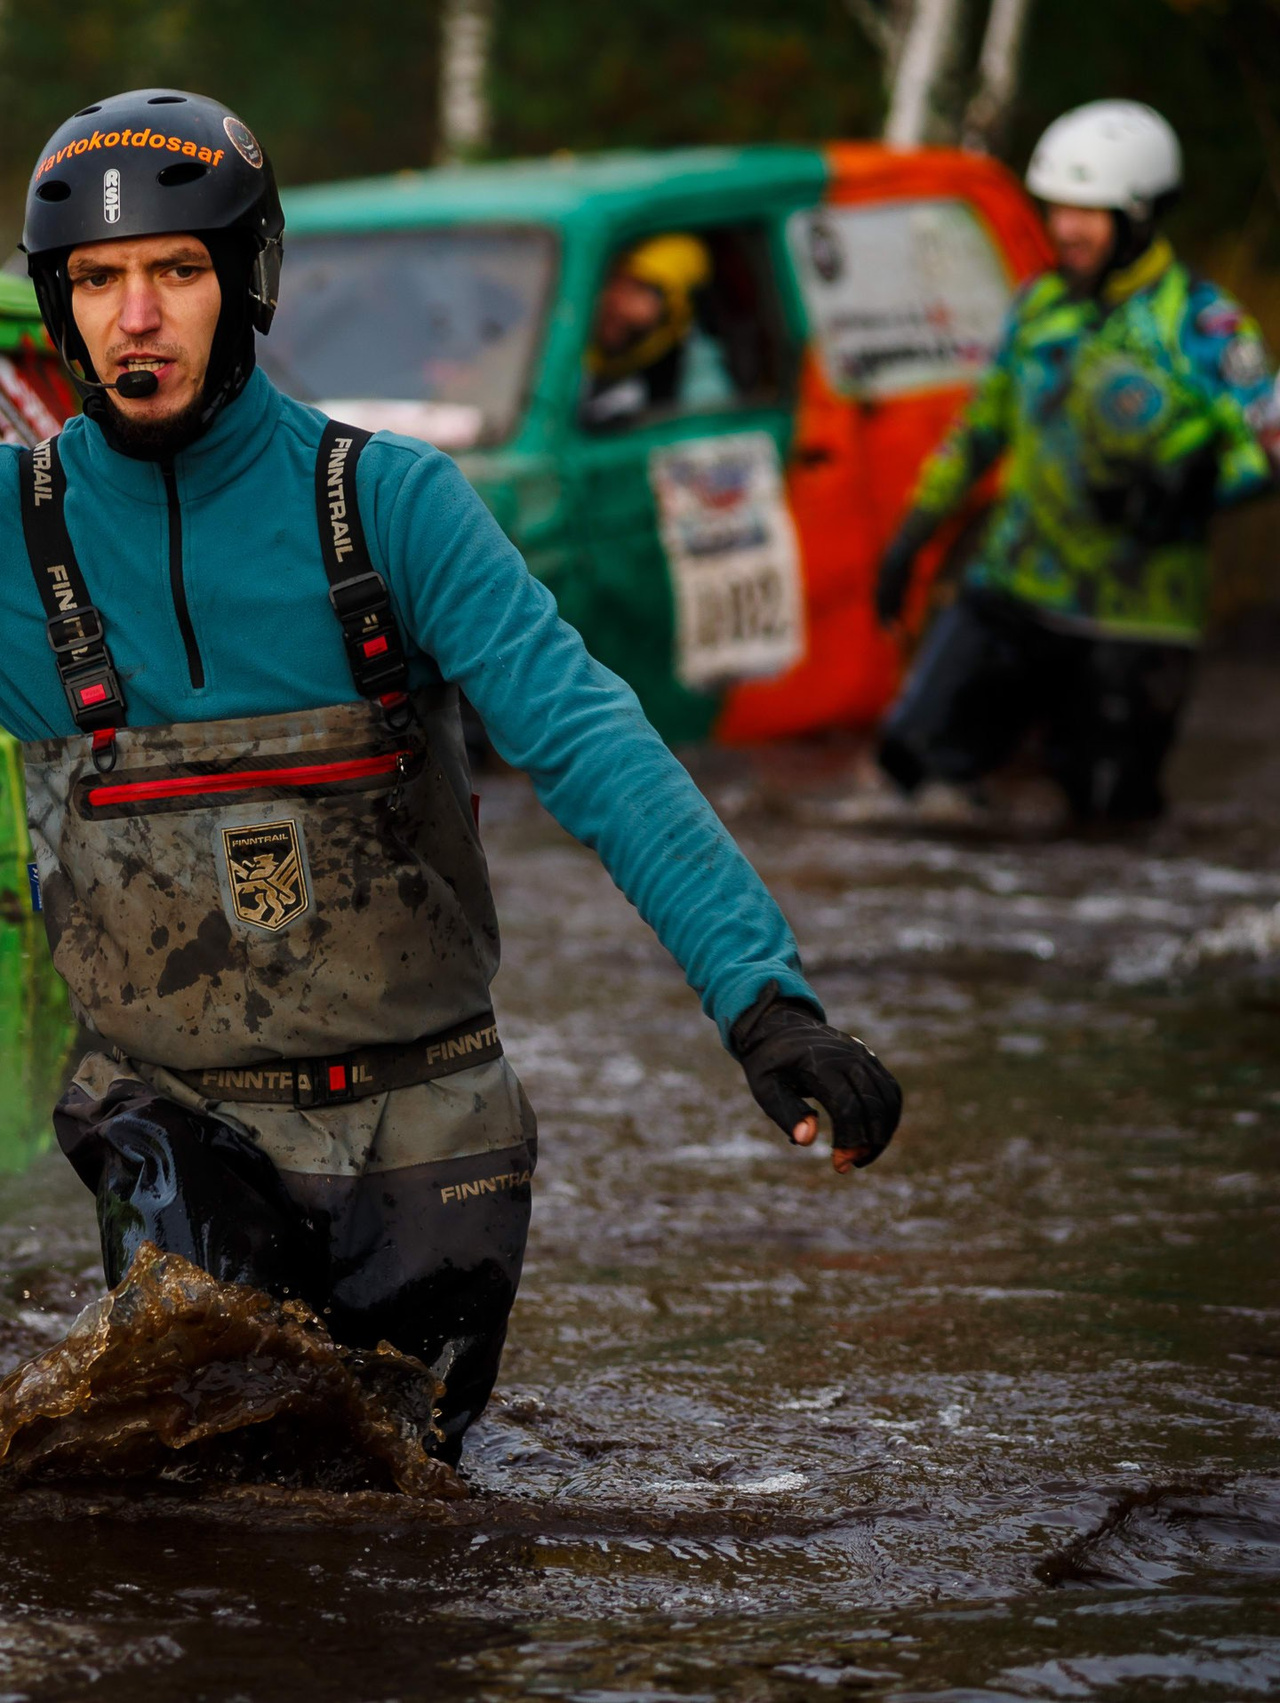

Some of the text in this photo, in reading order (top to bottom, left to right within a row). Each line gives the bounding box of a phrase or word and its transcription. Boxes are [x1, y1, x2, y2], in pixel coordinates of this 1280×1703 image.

[105, 169, 119, 222] RST
[327, 437, 354, 563] FINNTRAIL
[232, 833, 289, 848] FINNTRAIL
